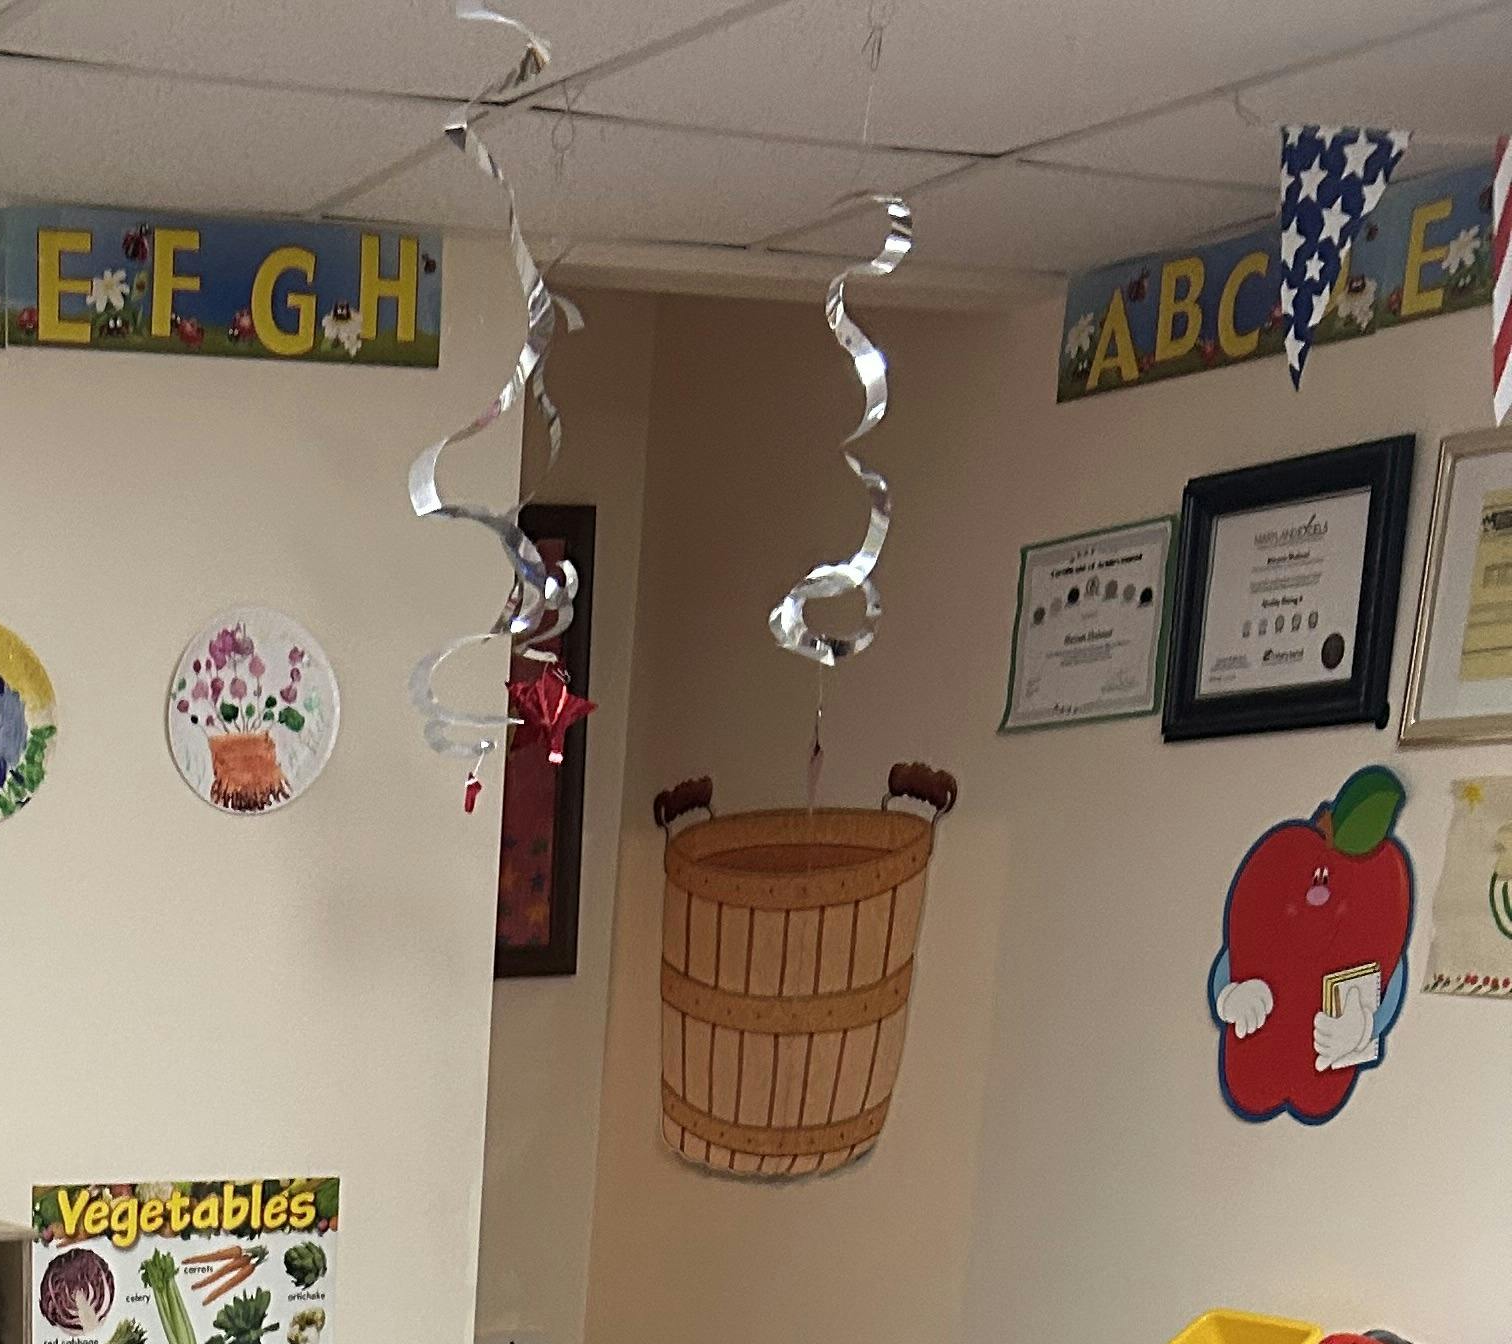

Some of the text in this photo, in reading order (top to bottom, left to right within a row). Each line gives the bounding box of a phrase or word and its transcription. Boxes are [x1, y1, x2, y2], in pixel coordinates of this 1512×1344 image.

[58, 1183, 316, 1247] Vegetables
[184, 1265, 213, 1274] carrots
[126, 1293, 151, 1303] celery
[288, 1291, 325, 1301] artichoke
